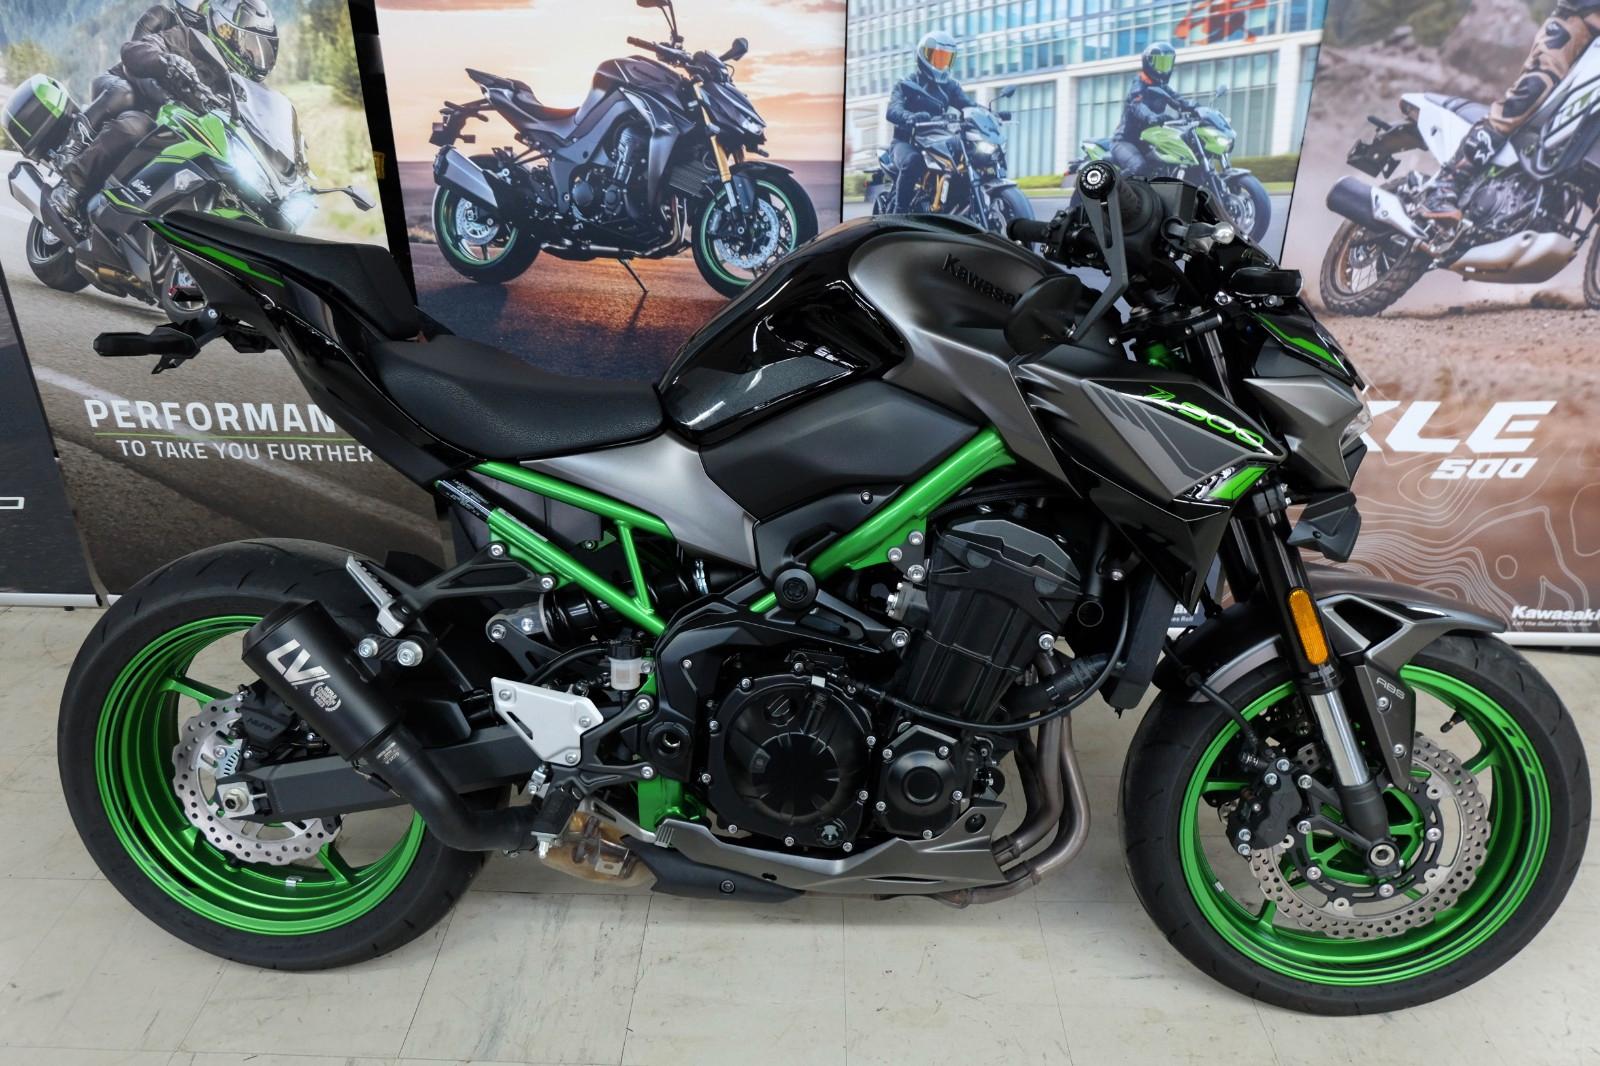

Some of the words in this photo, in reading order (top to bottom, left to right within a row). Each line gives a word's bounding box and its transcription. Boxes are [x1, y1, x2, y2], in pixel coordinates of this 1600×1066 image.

[115, 439, 147, 458] TO
[151, 440, 209, 460] TAKE
[213, 442, 261, 461] YOU
[267, 443, 374, 463] FURTHER
[1430, 457, 1539, 480] 500
[1376, 676, 1405, 700] ABS
